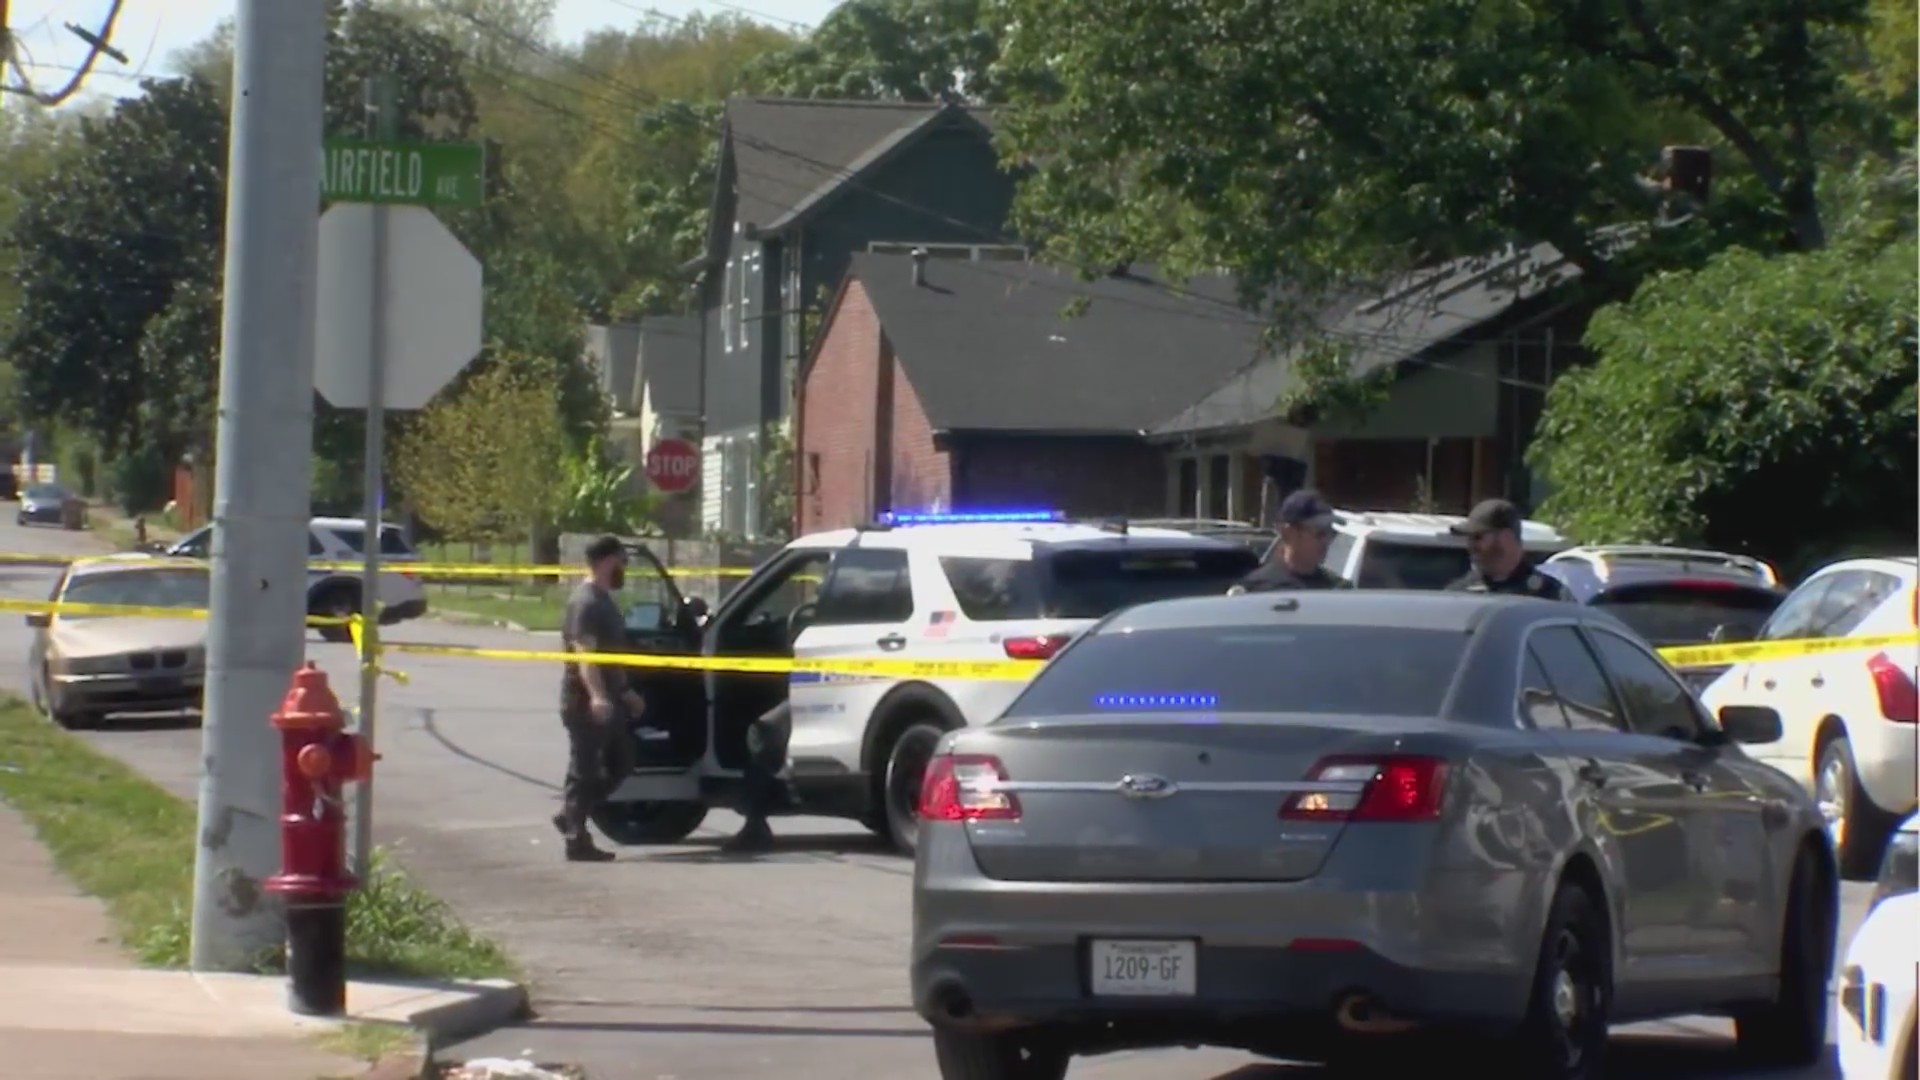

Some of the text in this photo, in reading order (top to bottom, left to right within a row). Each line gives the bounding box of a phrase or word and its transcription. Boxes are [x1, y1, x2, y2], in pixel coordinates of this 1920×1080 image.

[318, 148, 461, 200] AIRFIELD AVE
[648, 454, 697, 477] STOP
[1104, 955, 1182, 981] 1209-GF
